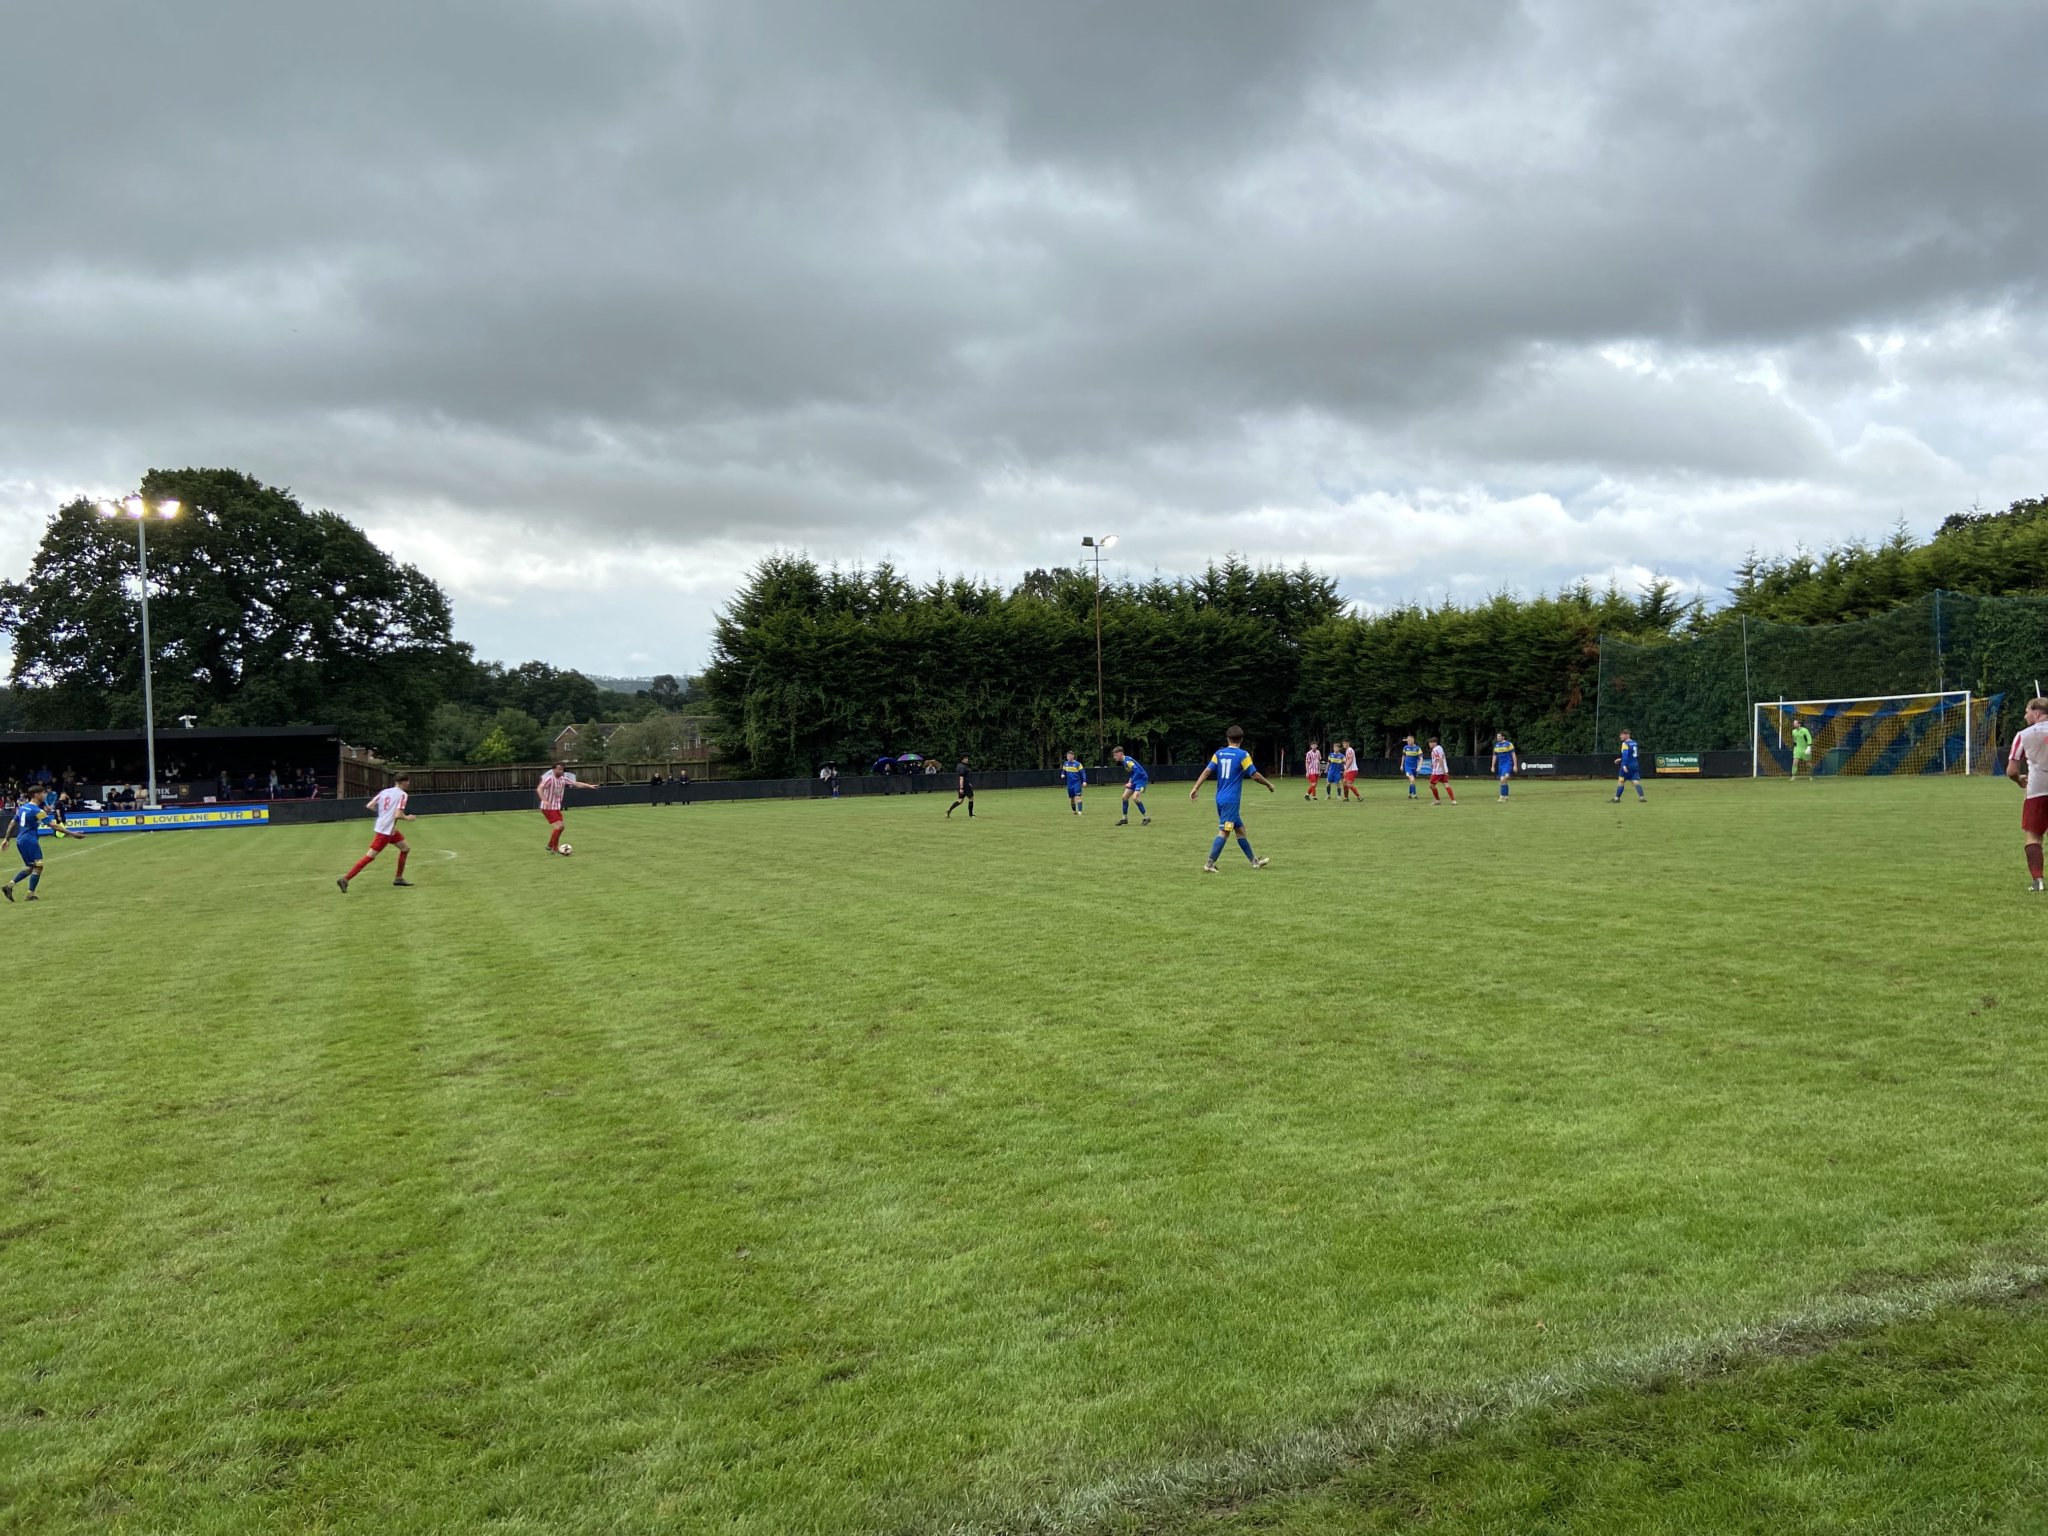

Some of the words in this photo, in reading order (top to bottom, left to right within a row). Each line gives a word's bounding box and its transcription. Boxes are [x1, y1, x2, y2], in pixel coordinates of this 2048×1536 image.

[1220, 758, 1232, 779] 11
[383, 796, 391, 811] 8
[115, 817, 128, 825] TO
[153, 815, 179, 824] LOVE
[182, 813, 209, 822] LANE
[219, 811, 244, 820] UTR
